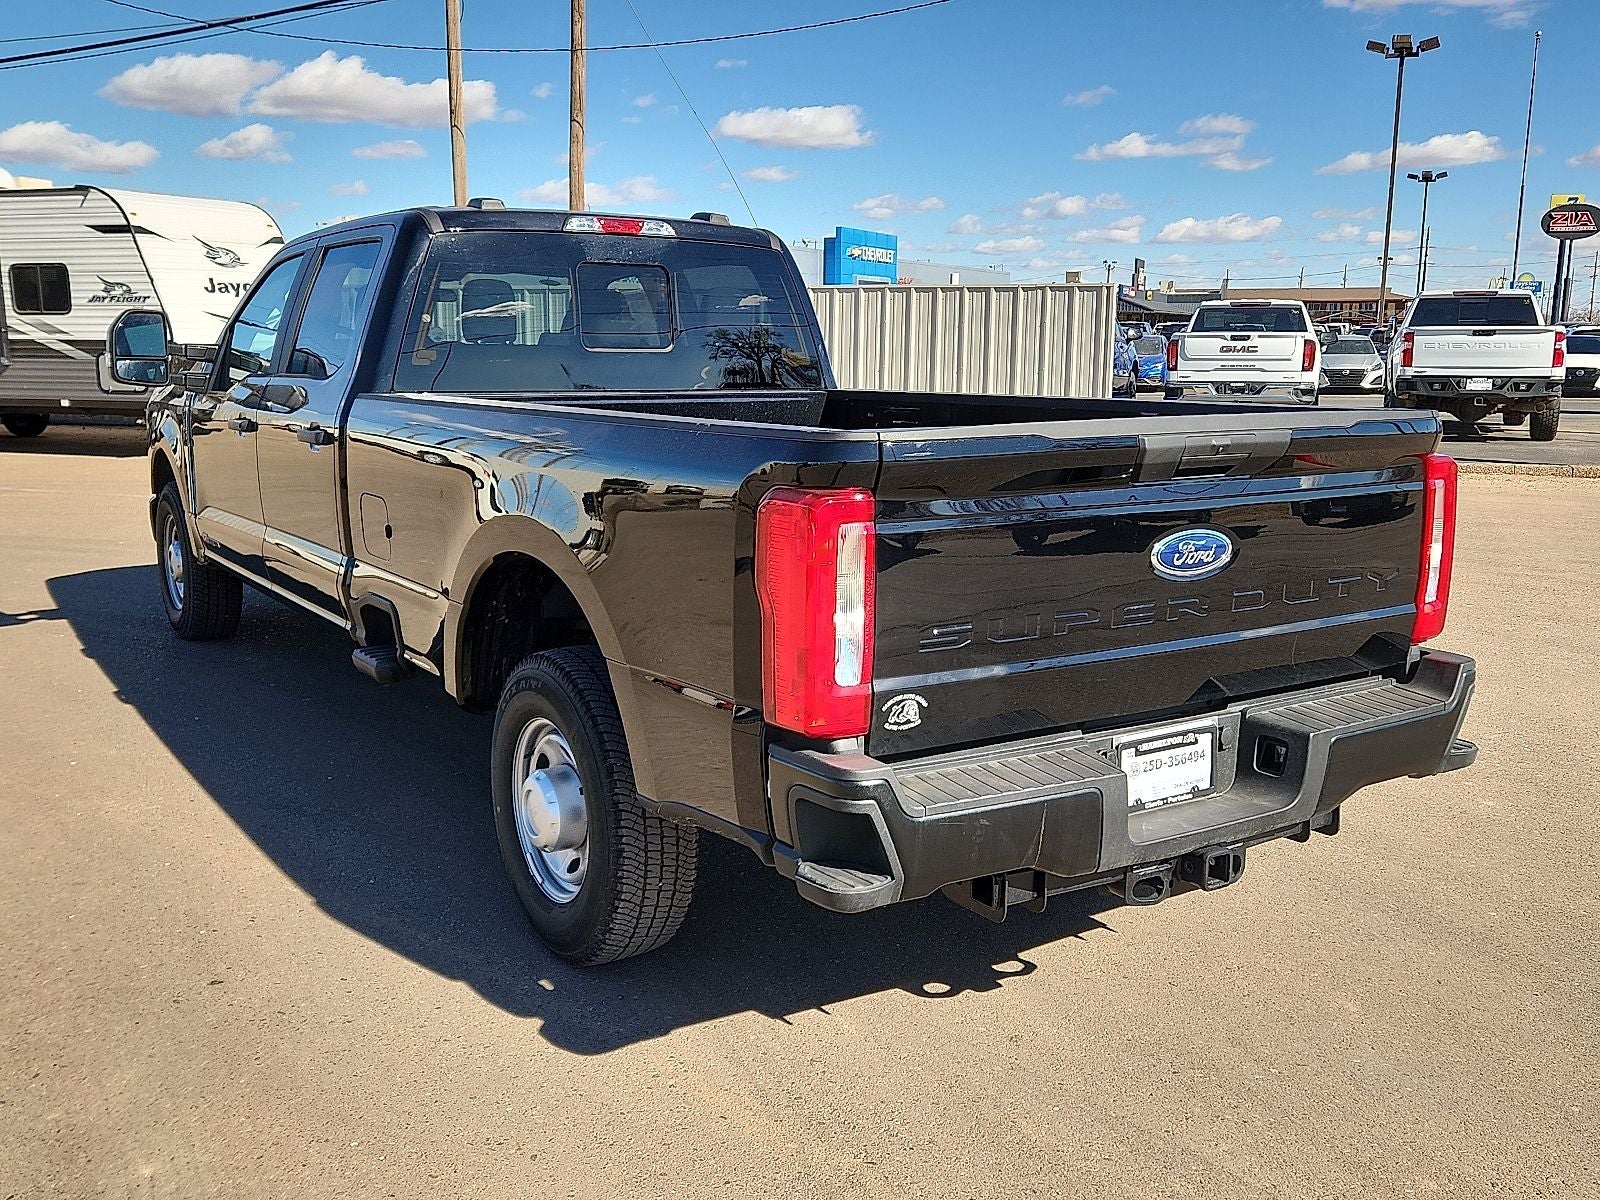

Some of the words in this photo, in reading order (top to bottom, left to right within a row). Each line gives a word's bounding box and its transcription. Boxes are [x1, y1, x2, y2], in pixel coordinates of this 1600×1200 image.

[1550, 211, 1596, 226] ZIA
[862, 247, 895, 263] CHEVROLET
[88, 295, 108, 303] JAY
[109, 295, 151, 303] FLIGHT
[1219, 345, 1259, 354] GMC
[1422, 342, 1545, 350] CHEVROLET
[1173, 539, 1217, 566] Ford
[918, 595, 1211, 654] SUPER
[1232, 568, 1400, 613] DUTY
[1142, 749, 1205, 772] 25D-356494
